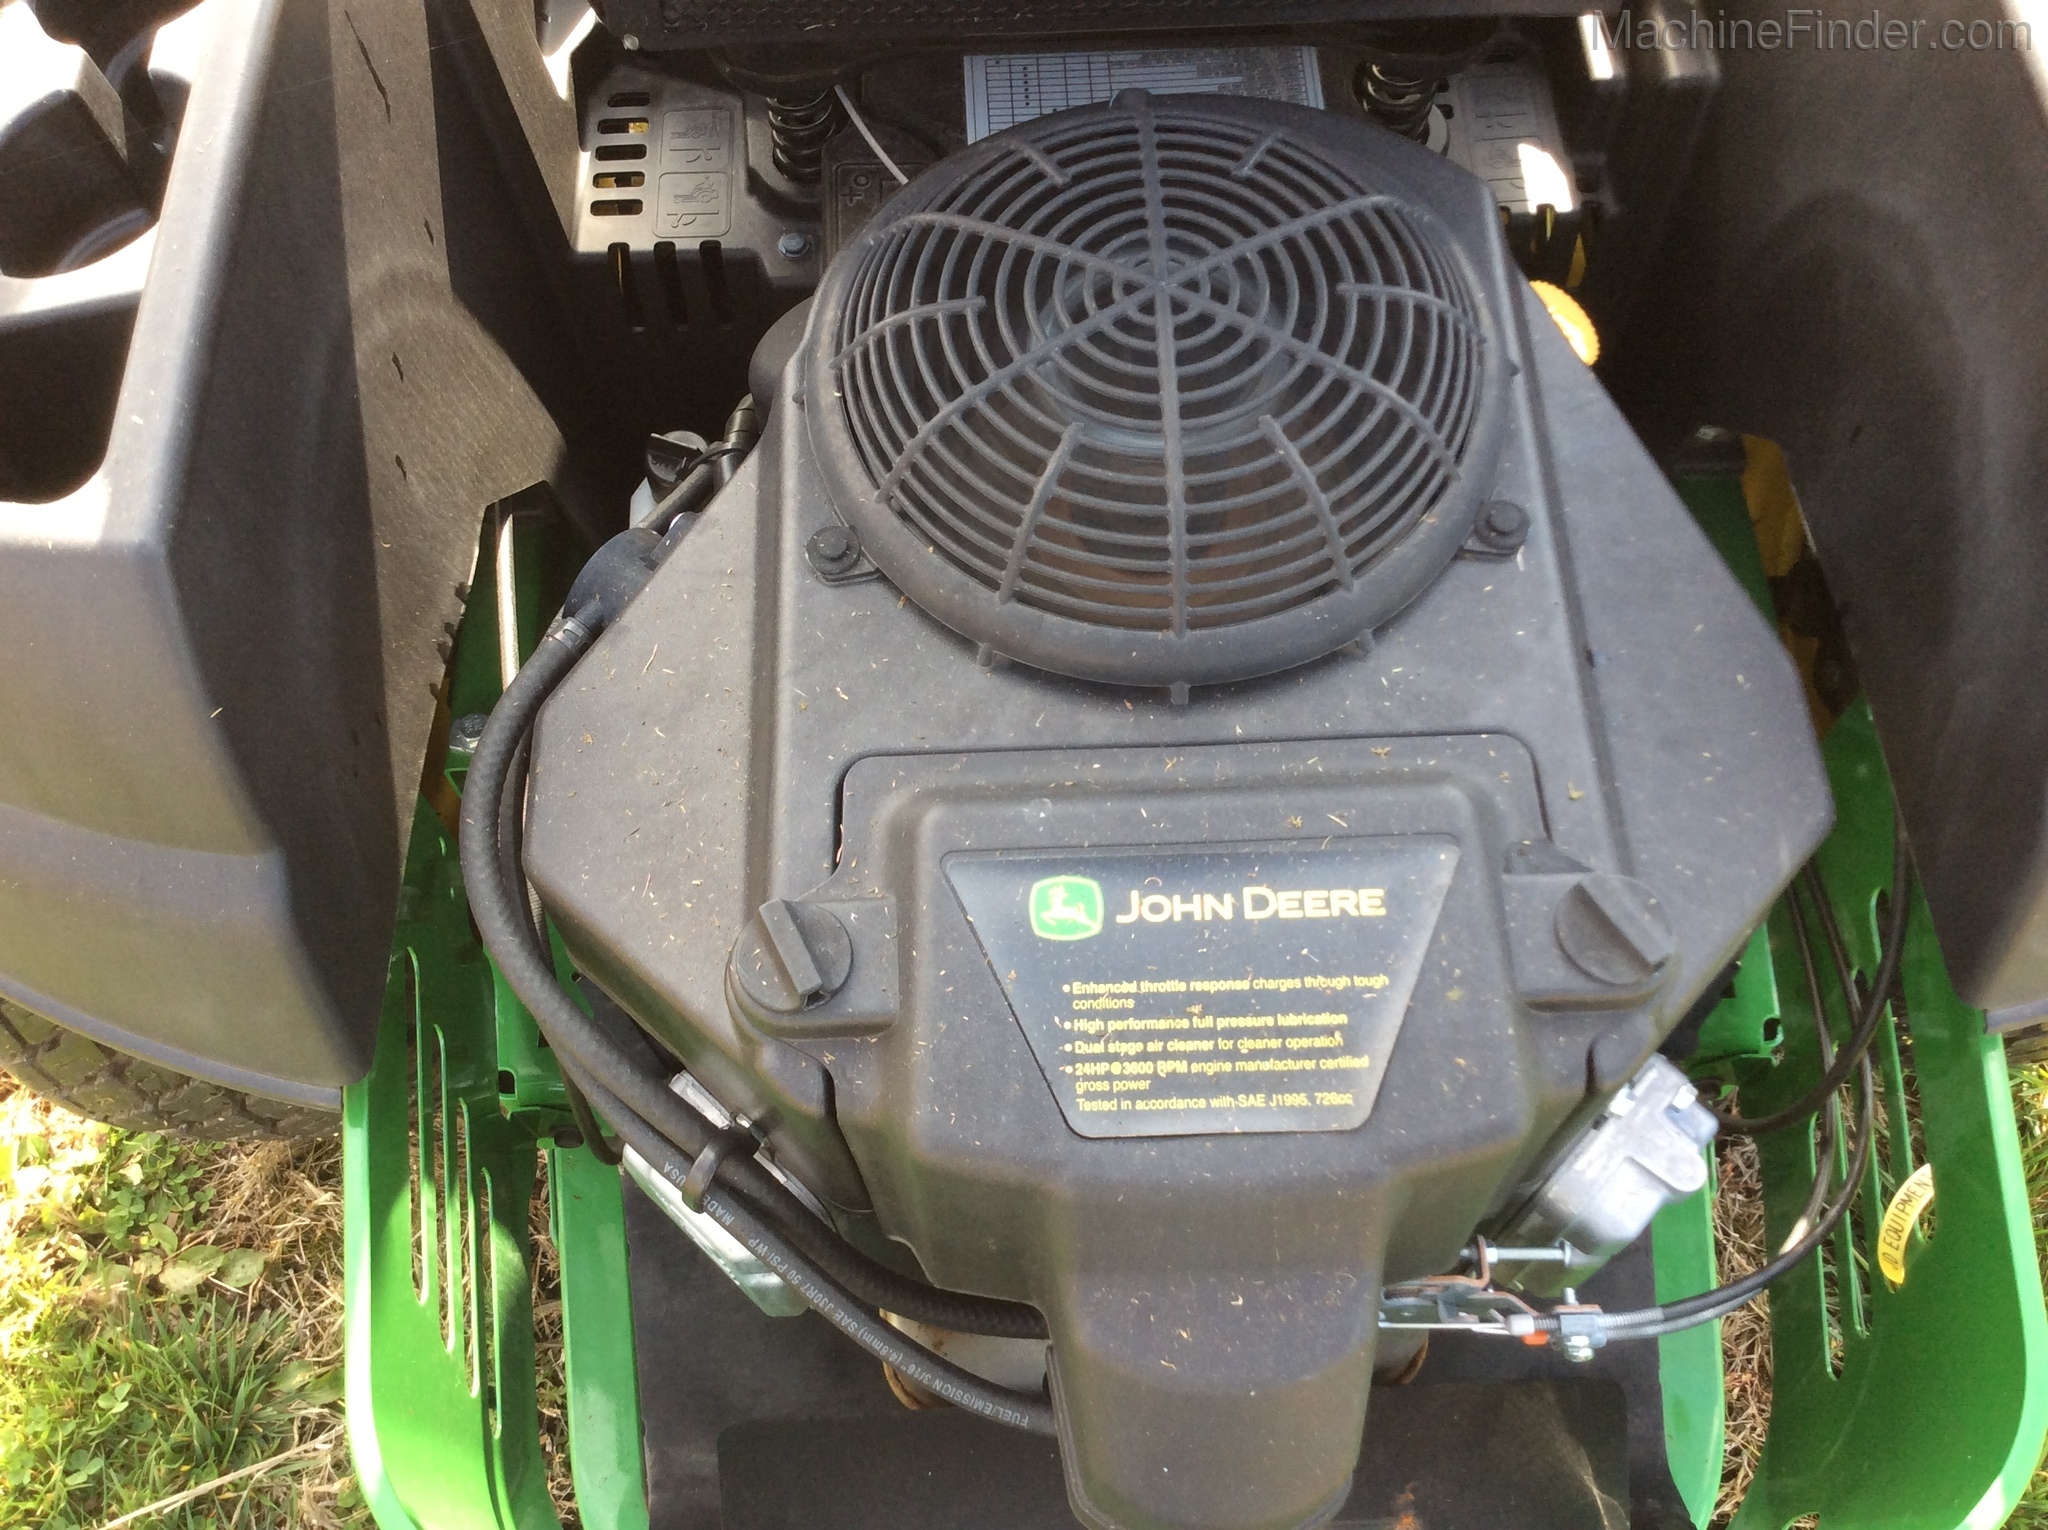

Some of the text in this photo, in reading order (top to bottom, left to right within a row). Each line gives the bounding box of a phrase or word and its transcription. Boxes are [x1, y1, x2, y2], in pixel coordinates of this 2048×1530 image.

[1115, 887, 1386, 924] JOHN DEERE
[1072, 973, 1389, 995] Enhanced throttle response charges through tough
[1072, 998, 1135, 1010] conditions
[1073, 1012, 1348, 1034] High performance full pressure lubrication
[1074, 1034, 1344, 1056] Dual stage air cleaner for cleaner operation
[1157, 1060, 1188, 1074] RPM
[1190, 1061, 1233, 1075] engine
[1235, 1058, 1317, 1072] manufacturer
[1318, 1054, 1370, 1070] certified
[1075, 1079, 1151, 1094] gross power
[1077, 1098, 1118, 1111] Tested
[1120, 1098, 1132, 1110] in
[1135, 1096, 1207, 1110] accordance
[1210, 1095, 1235, 1109] with
[1238, 1094, 1266, 1108] SAE
[663, 1160, 687, 1187] USA
[748, 1238, 769, 1257] WP
[767, 1252, 789, 1273] PSI
[786, 1269, 802, 1285] 50
[800, 1282, 835, 1312] J30R7
[832, 1309, 858, 1333] SAE
[857, 1326, 904, 1365] (4.8mm)
[932, 1378, 1029, 1428] FUEL/EMISSION
